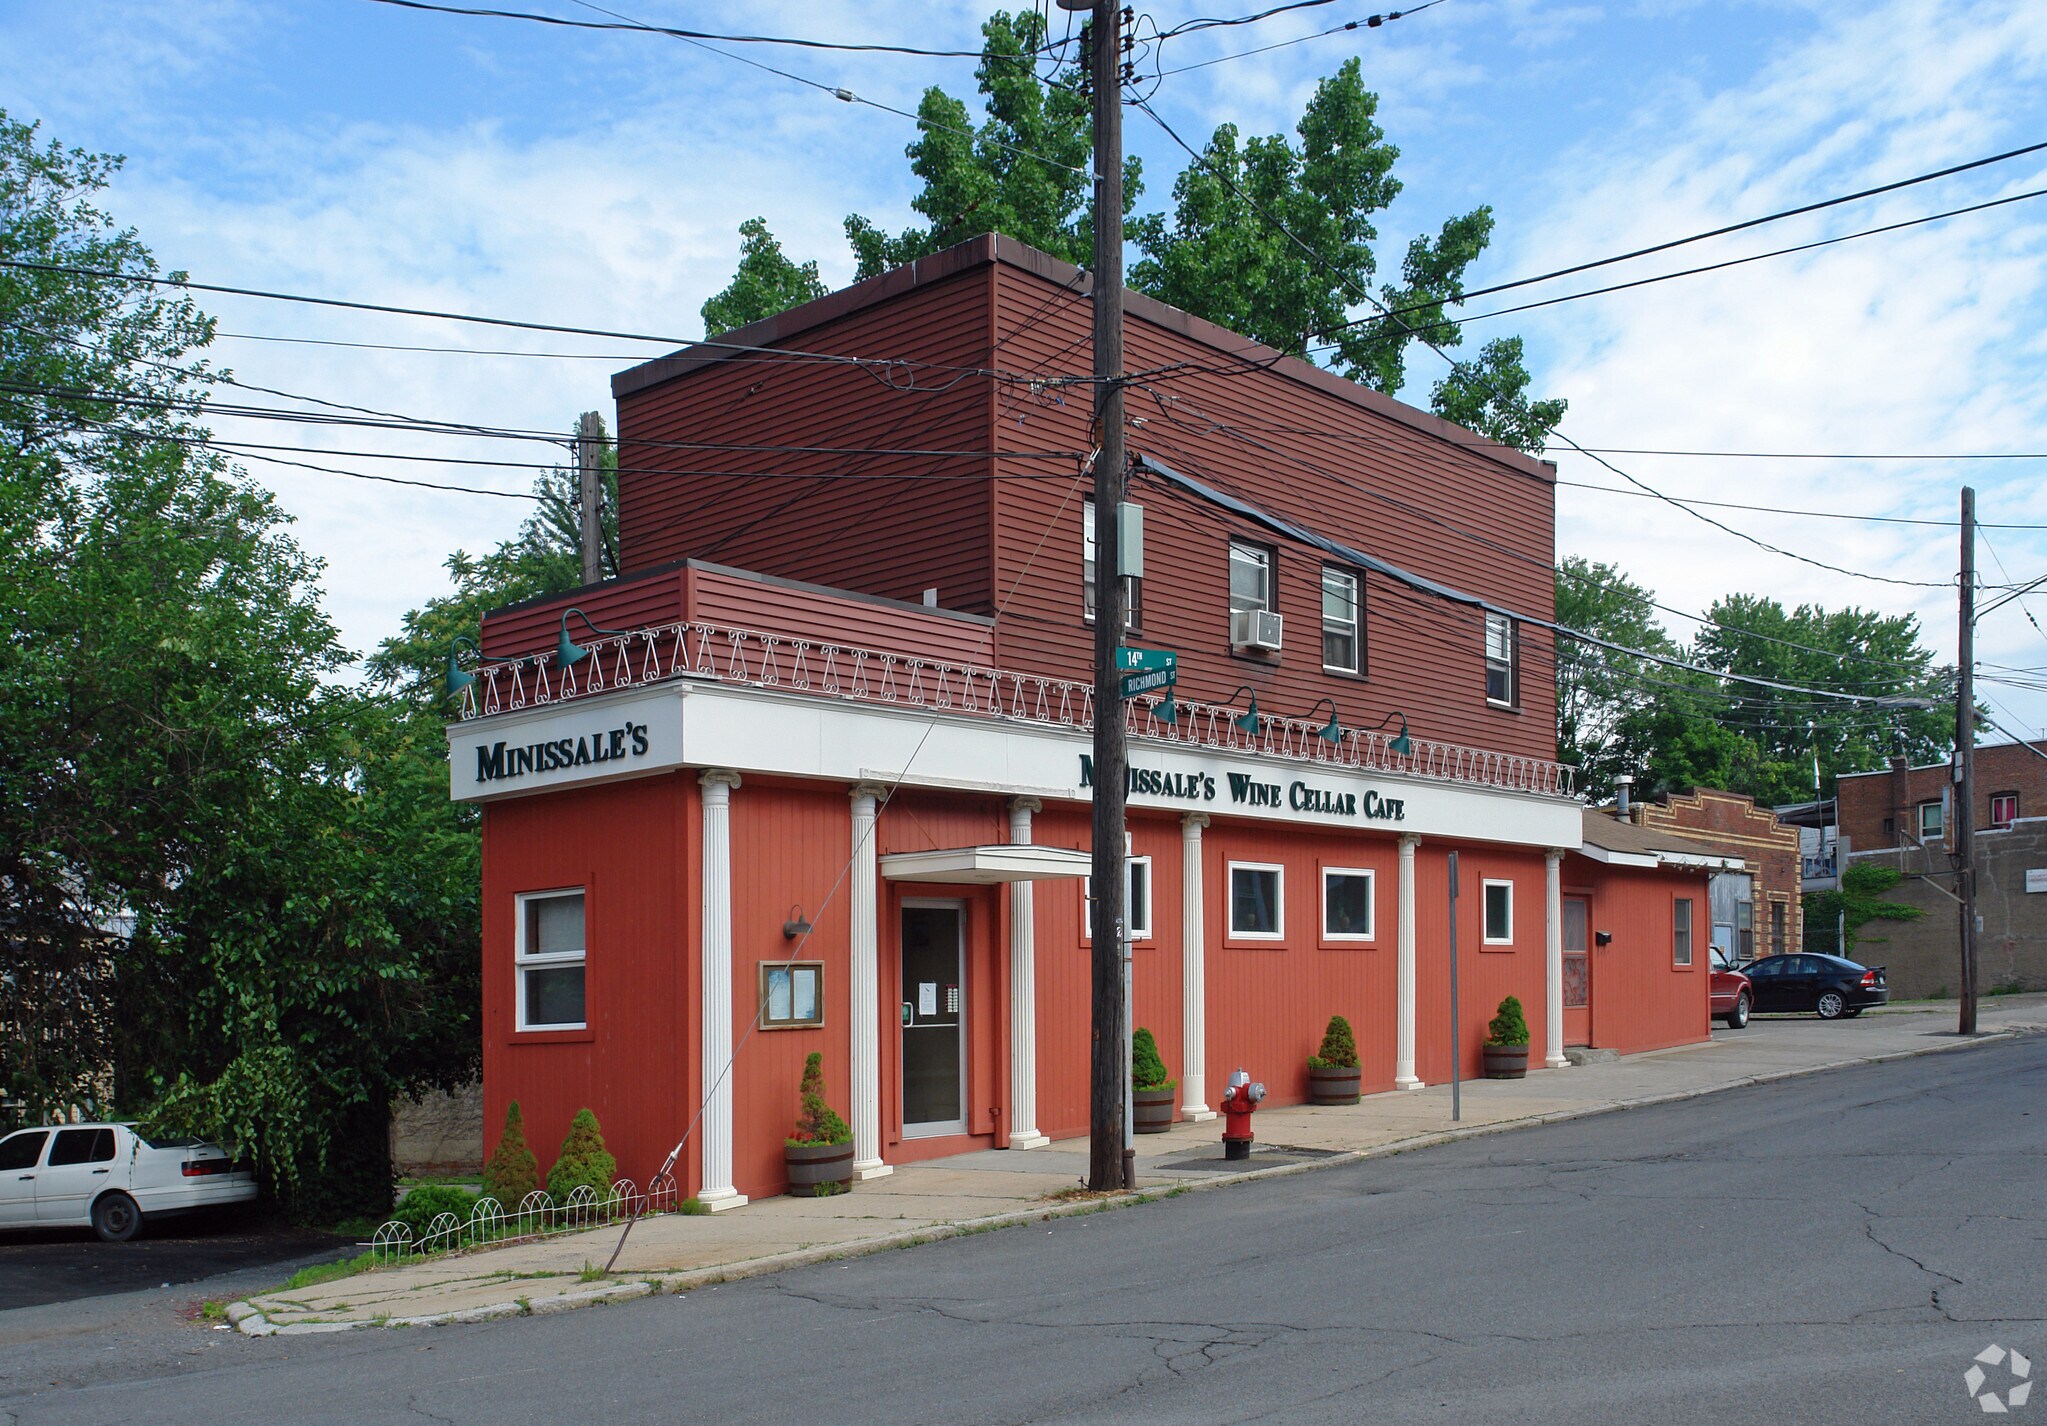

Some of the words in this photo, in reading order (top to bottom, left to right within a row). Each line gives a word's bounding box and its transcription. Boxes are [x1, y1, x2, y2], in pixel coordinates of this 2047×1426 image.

[1127, 651, 1143, 666] 14TH
[1166, 658, 1172, 666] ST
[1128, 671, 1167, 692] RICHMOND
[1170, 671, 1175, 679] ST
[475, 721, 649, 782] MINISSALE'S
[1226, 772, 1281, 808] WINE
[1289, 781, 1357, 815] CELLAR
[1363, 790, 1405, 821] CAFE
